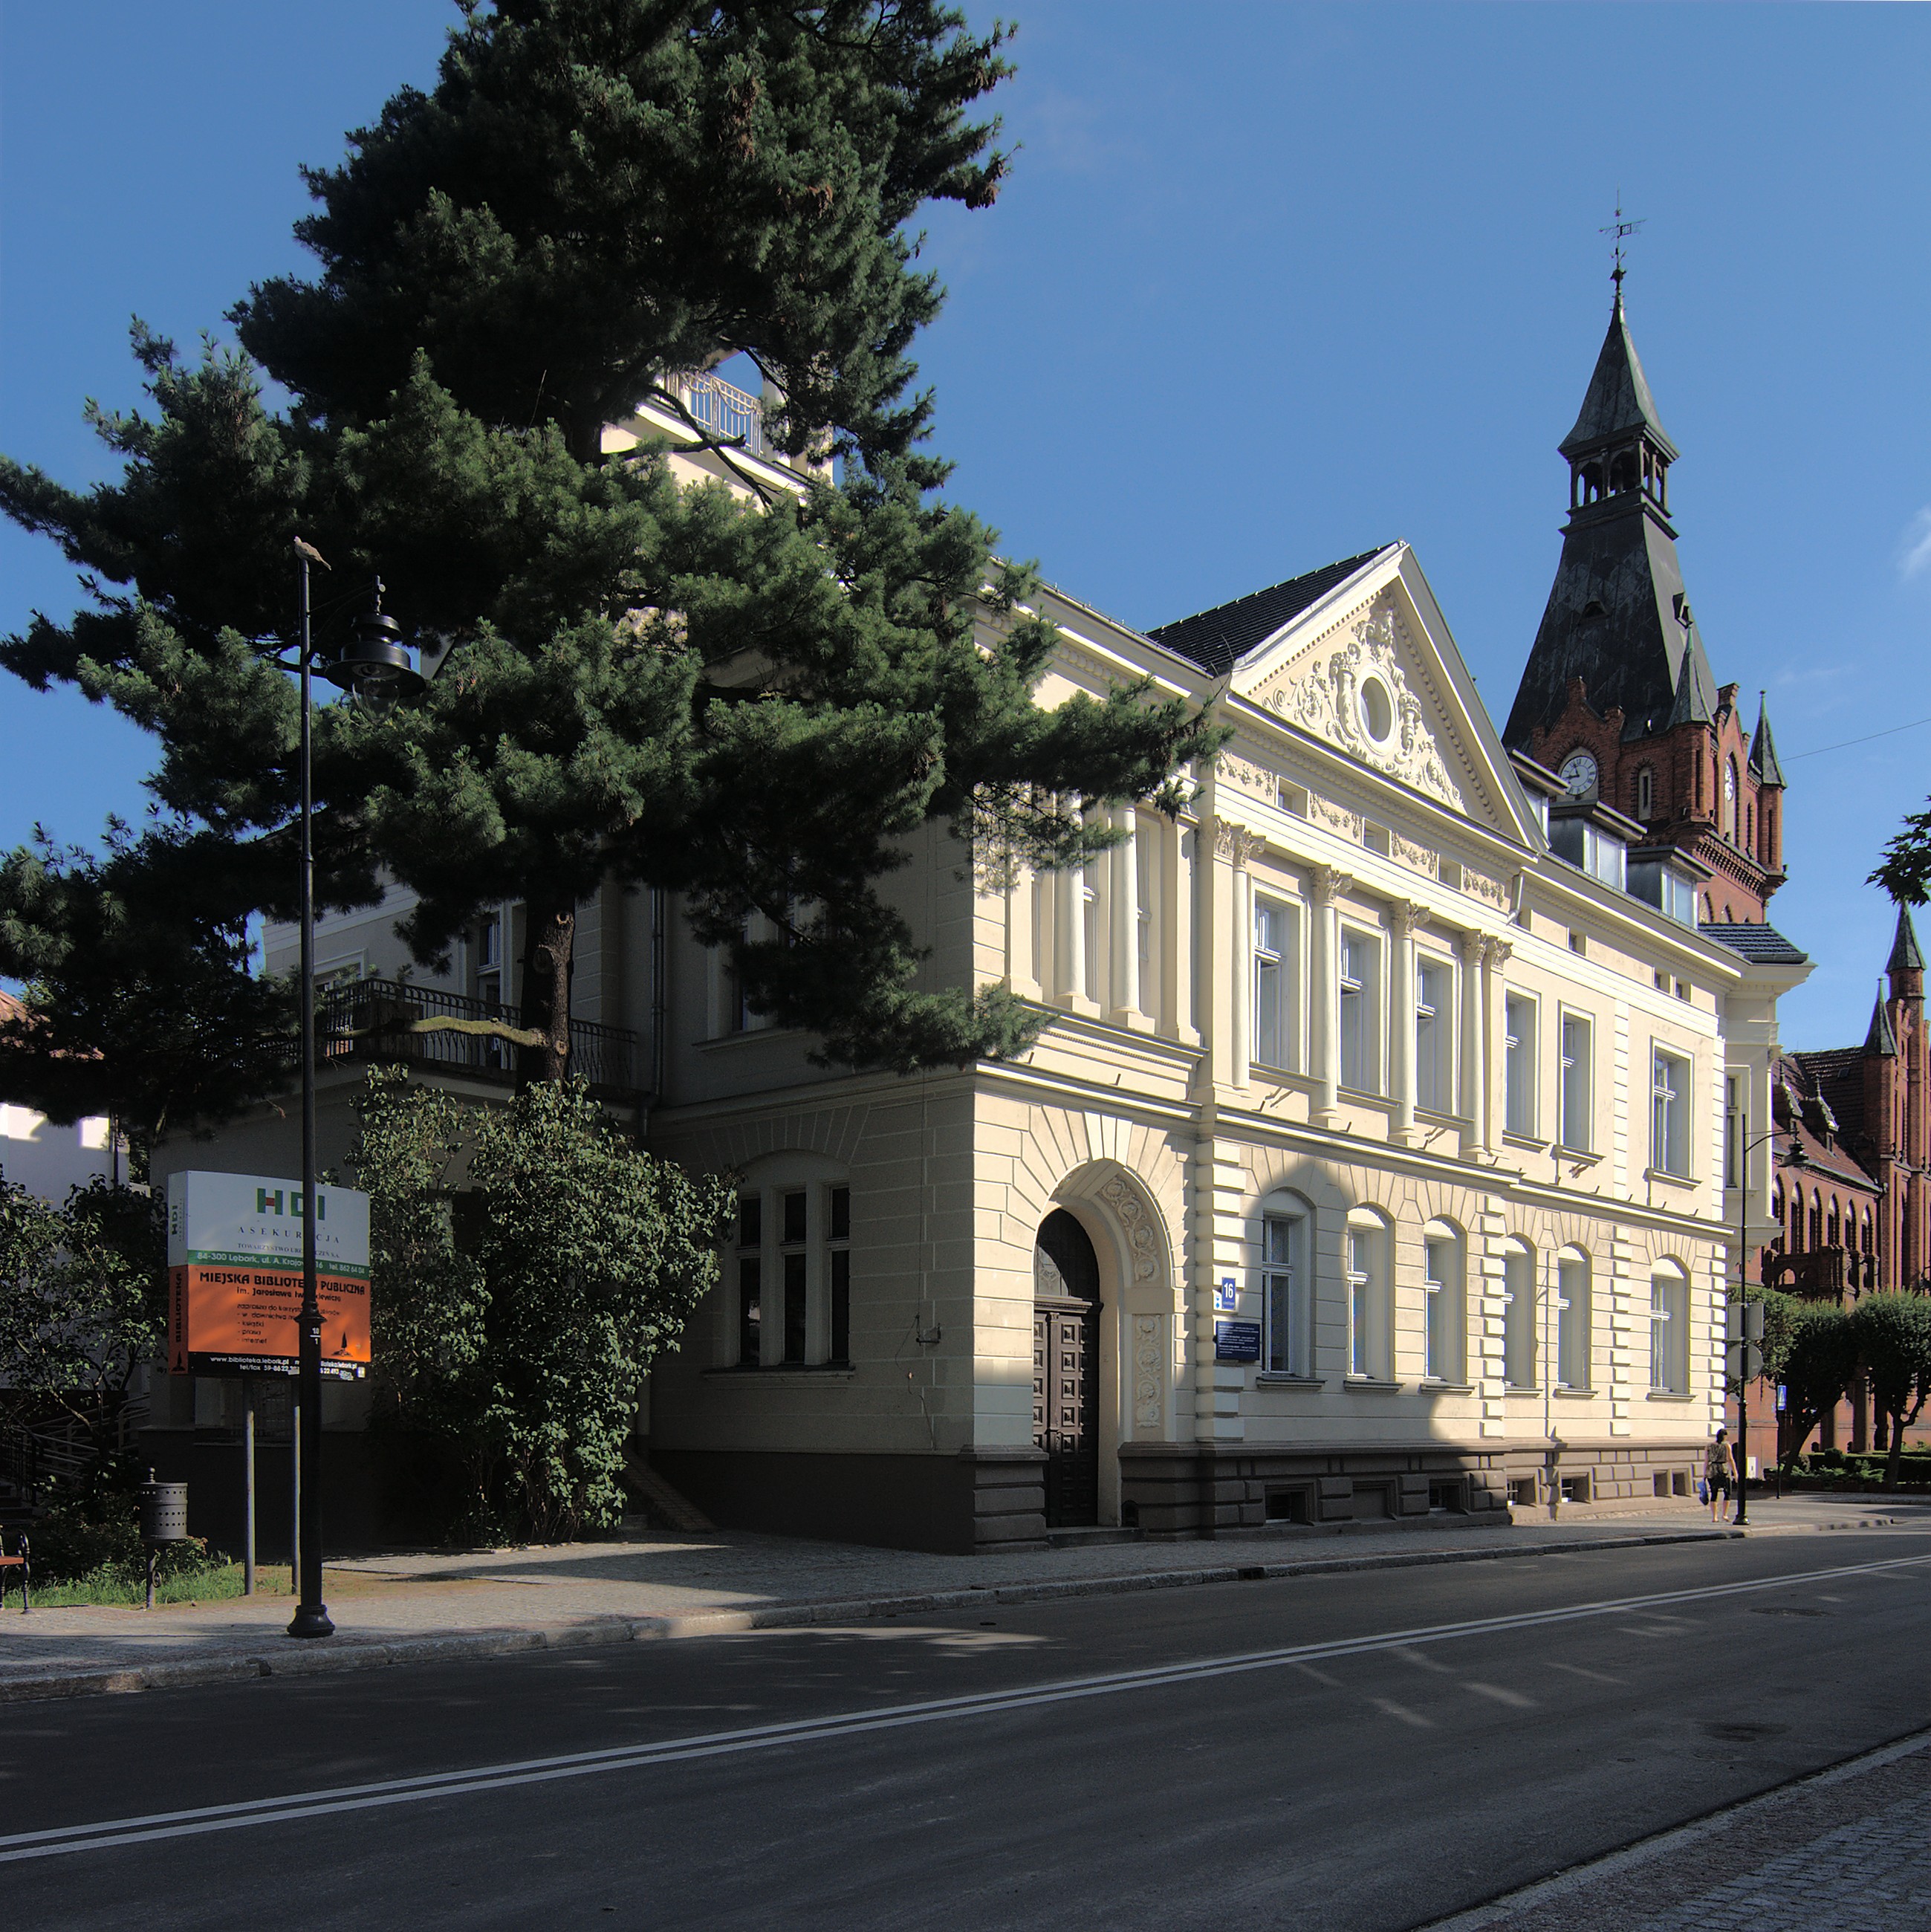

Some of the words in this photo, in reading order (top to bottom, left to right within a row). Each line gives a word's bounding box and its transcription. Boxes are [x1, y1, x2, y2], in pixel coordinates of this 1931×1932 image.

[256, 1187, 325, 1220] HDI
[238, 1226, 340, 1244] ASEKURCJA
[197, 1252, 227, 1261] 84-300
[282, 1258, 304, 1268] Krajo
[199, 1272, 250, 1285] MIEJSKA
[254, 1275, 317, 1289] BIBLIOTE
[320, 1280, 365, 1295] PUBLICZNA
[237, 1286, 250, 1294] im.
[1224, 1283, 1233, 1298] 16
